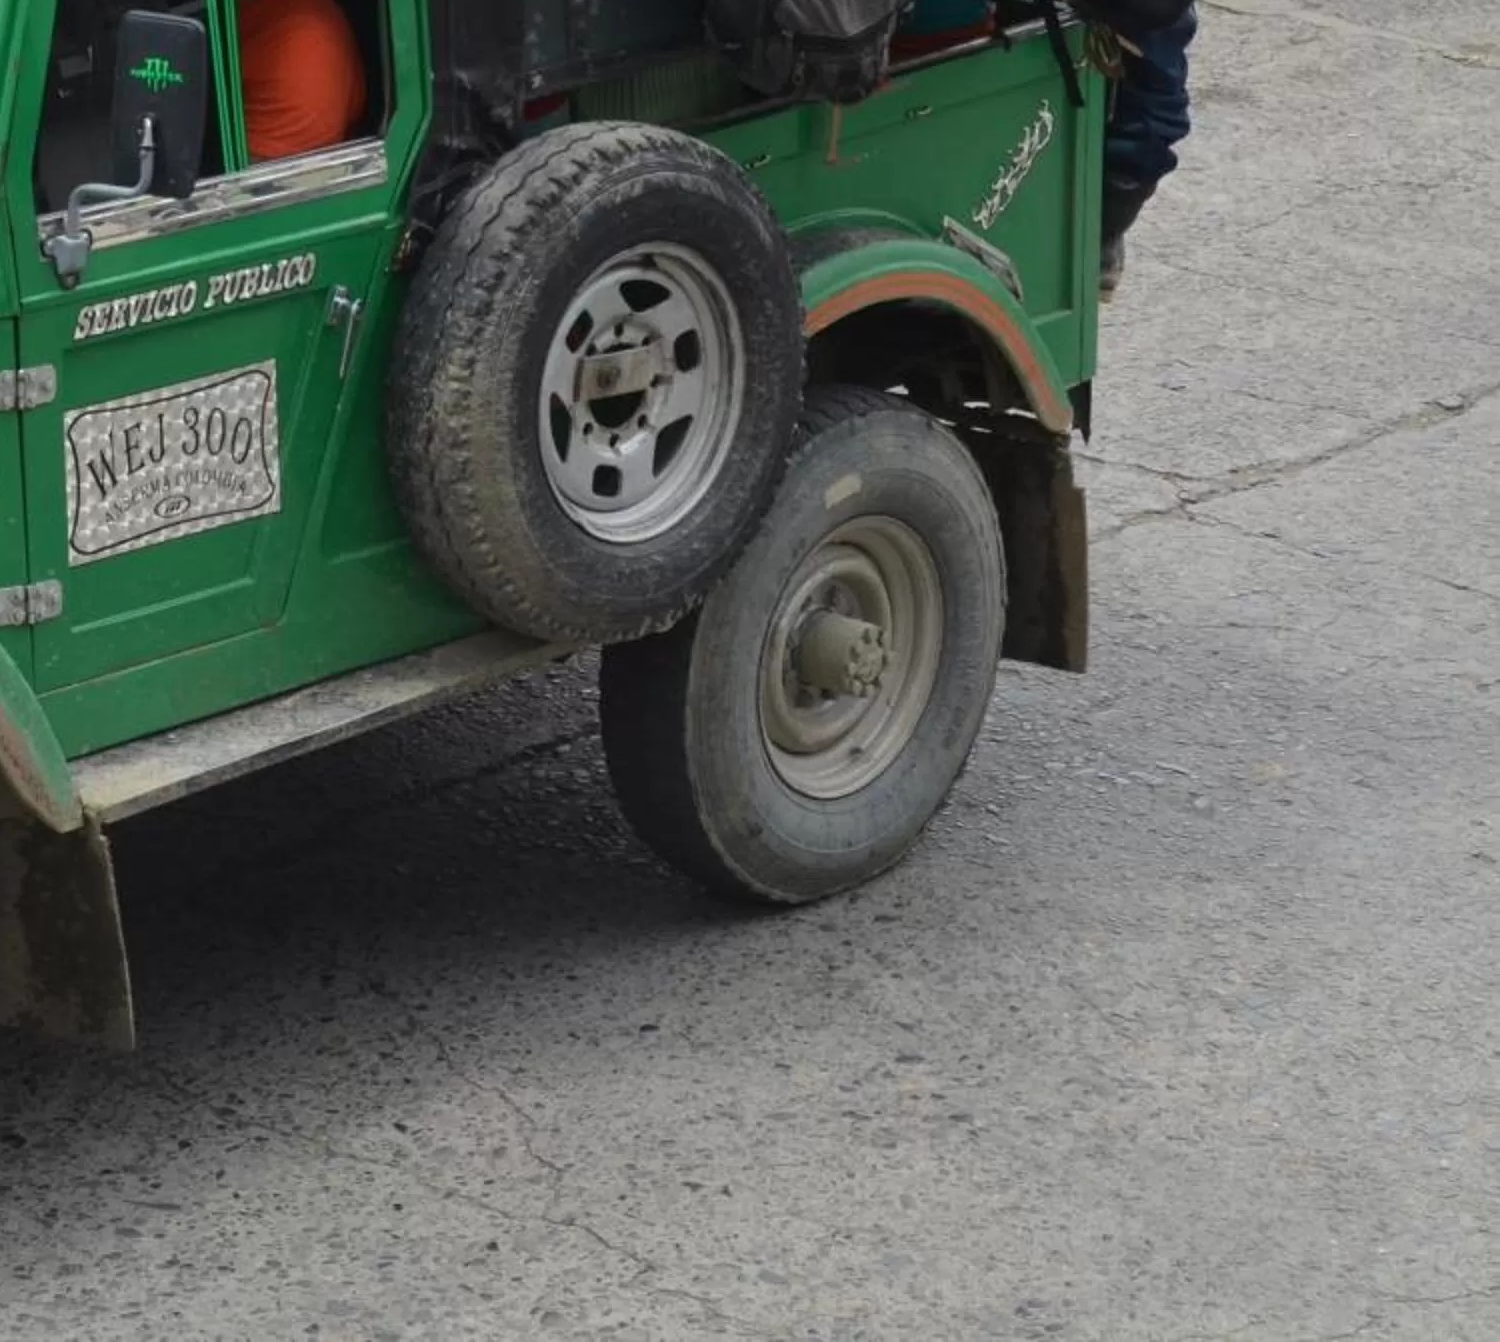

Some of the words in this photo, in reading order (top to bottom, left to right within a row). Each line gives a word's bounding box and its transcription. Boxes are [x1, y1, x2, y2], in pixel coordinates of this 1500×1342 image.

[73, 280, 198, 341] SERVICIO
[204, 252, 316, 309] PUBLICO
[87, 412, 166, 501] WEJ
[181, 406, 252, 466] 300
[104, 475, 172, 525] ANSERMA
